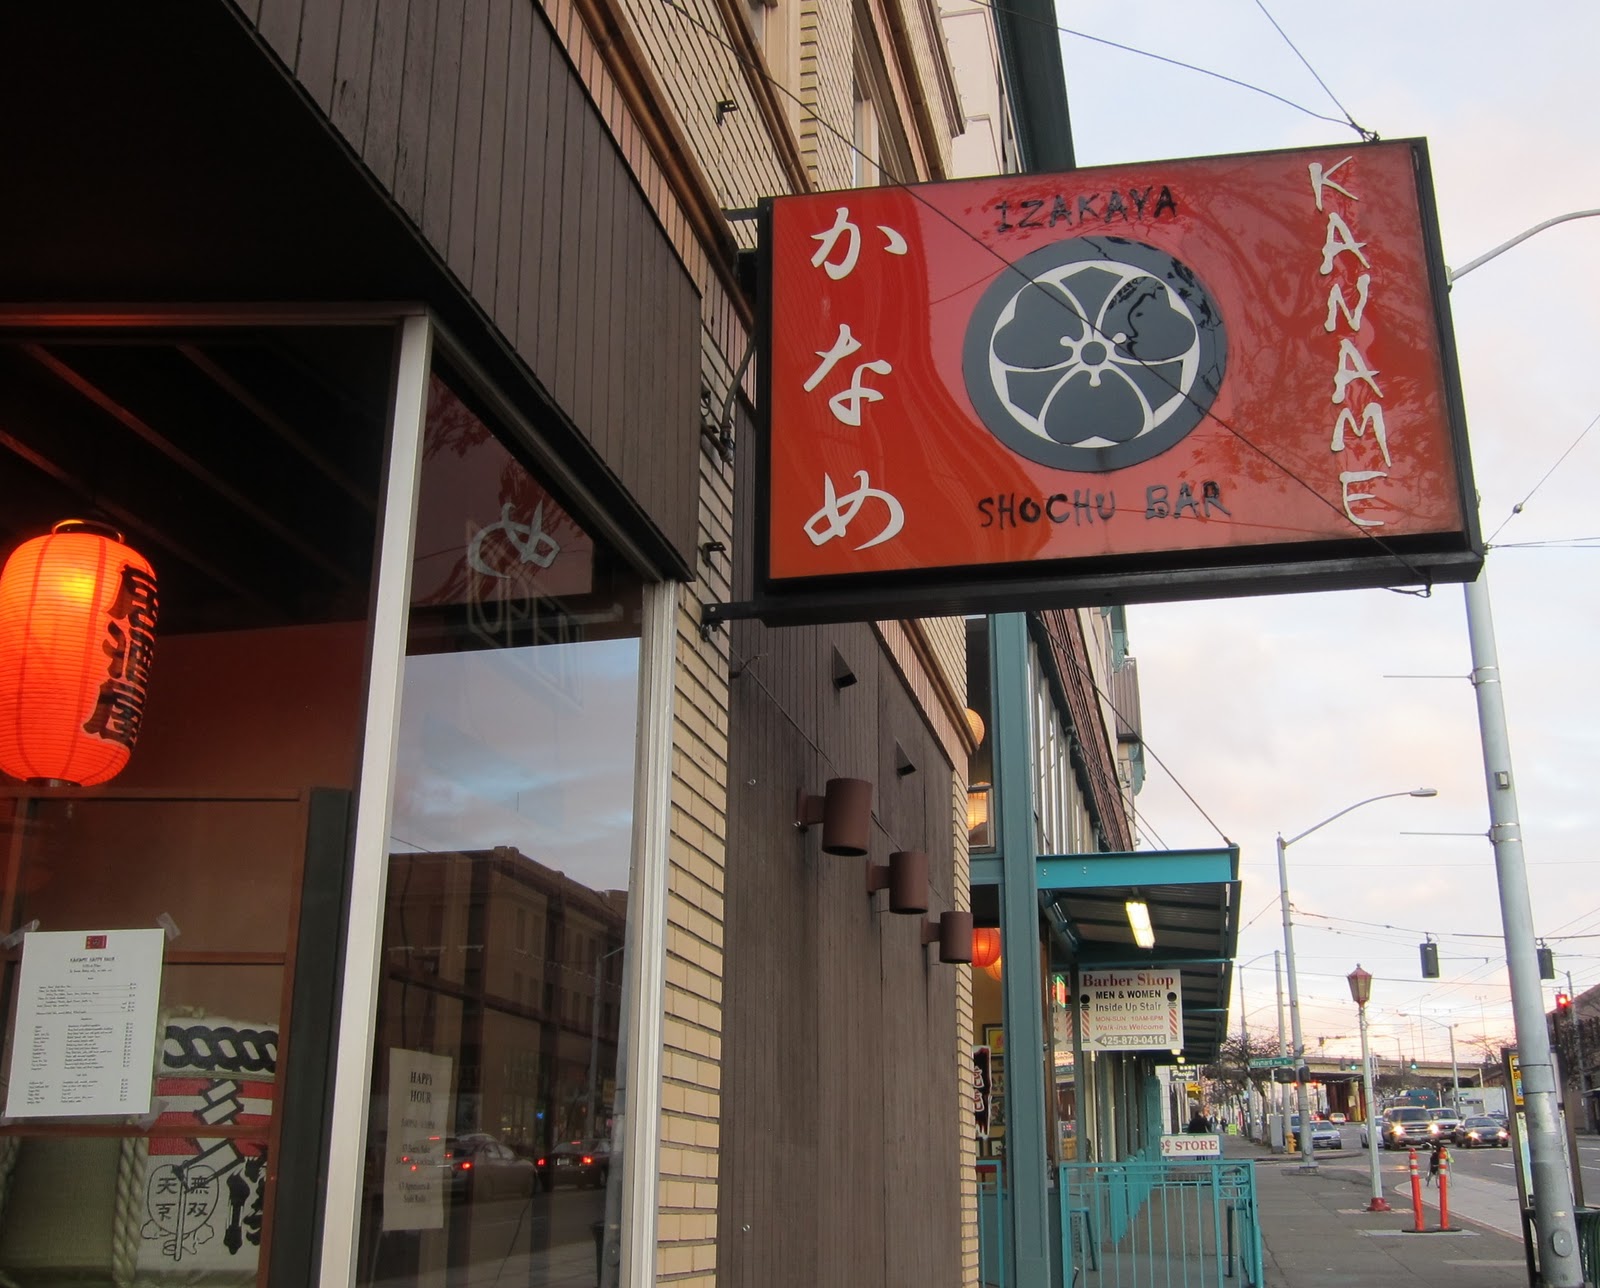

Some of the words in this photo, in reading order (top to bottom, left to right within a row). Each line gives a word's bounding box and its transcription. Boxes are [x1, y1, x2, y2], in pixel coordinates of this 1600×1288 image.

[994, 184, 1179, 233] IZAKAYA
[1307, 155, 1393, 528] KANAME
[803, 207, 908, 552] かなめ
[978, 489, 1116, 528] SHOCHU
[1146, 480, 1232, 520] BAR
[1083, 973, 1133, 987] Barber
[1137, 972, 1174, 990] Shop
[1095, 991, 1115, 999] MEN
[1118, 990, 1124, 999] &
[1127, 989, 1161, 999] WOMEN
[1095, 1003, 1123, 1012] Inside
[1125, 1002, 1137, 1012] Up
[1139, 1001, 1161, 1011] Stair
[1129, 1023, 1164, 1031] Welcome
[1101, 1035, 1165, 1045] 425-879-0416
[410, 1071, 433, 1087] HAPPY
[410, 1090, 432, 1105] HOUR
[1175, 1140, 1218, 1151] STORE
